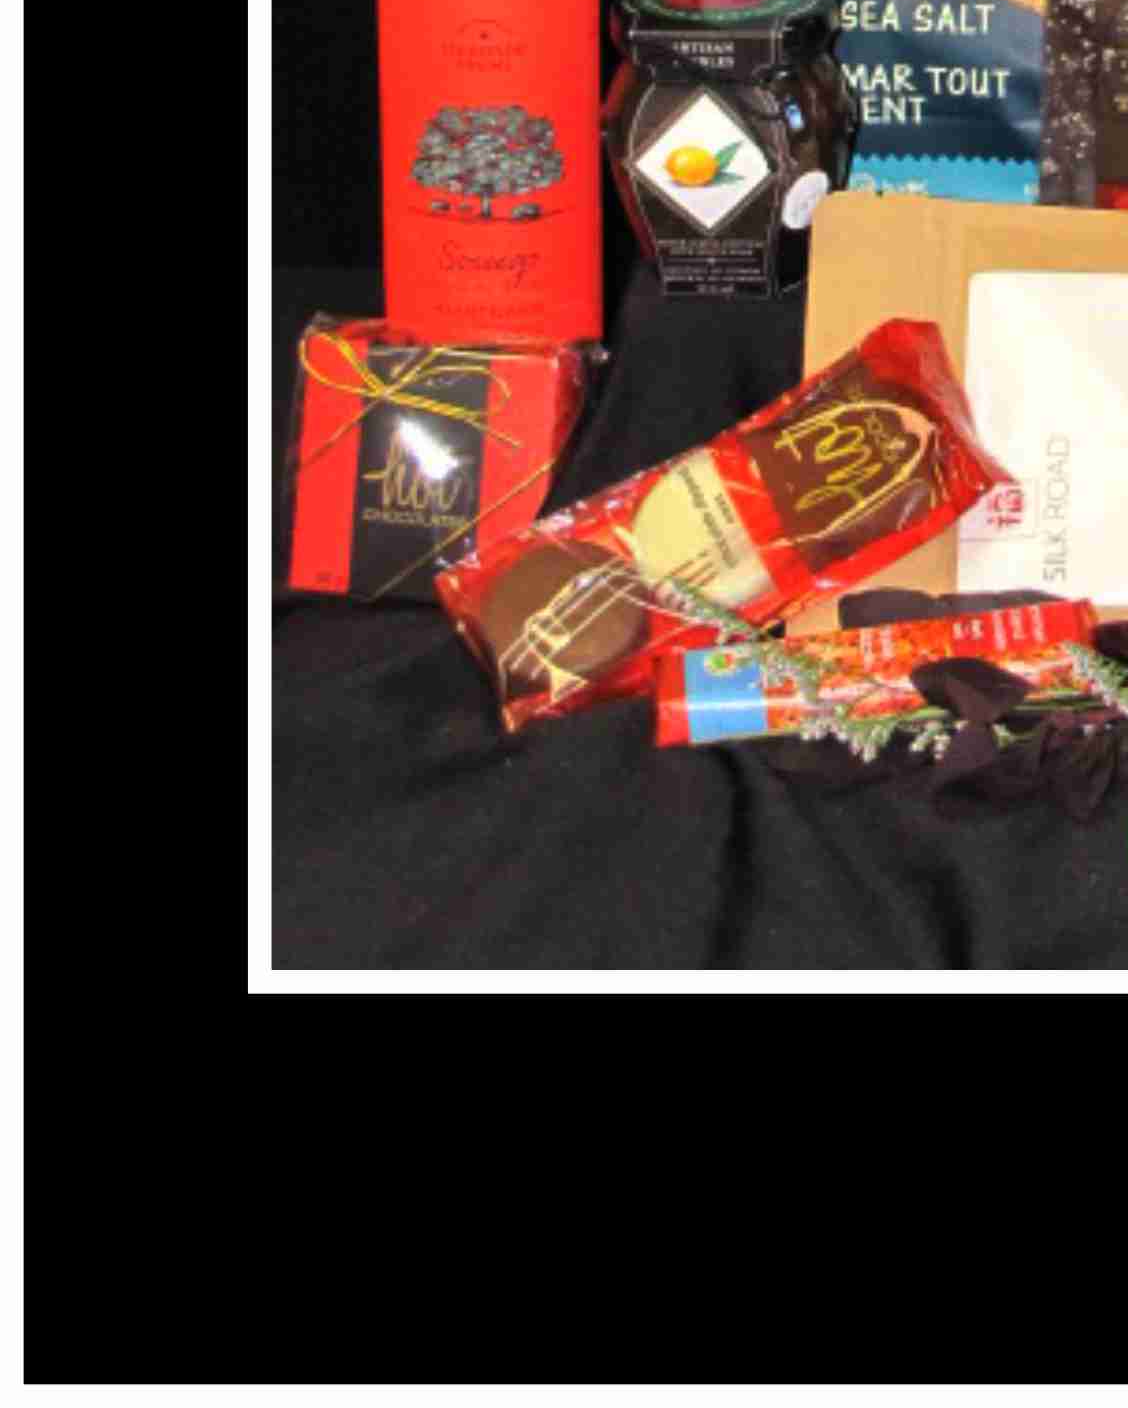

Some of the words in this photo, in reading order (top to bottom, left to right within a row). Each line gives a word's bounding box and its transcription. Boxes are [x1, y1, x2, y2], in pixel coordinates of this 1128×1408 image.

[840, 0, 900, 32] SEA
[912, 2, 996, 35] SALT
[841, 63, 917, 93] MAR
[924, 66, 1012, 98] TOUT
[860, 95, 927, 125] ENT
[1043, 435, 1070, 521] ROAD
[1042, 527, 1068, 582] SILK
